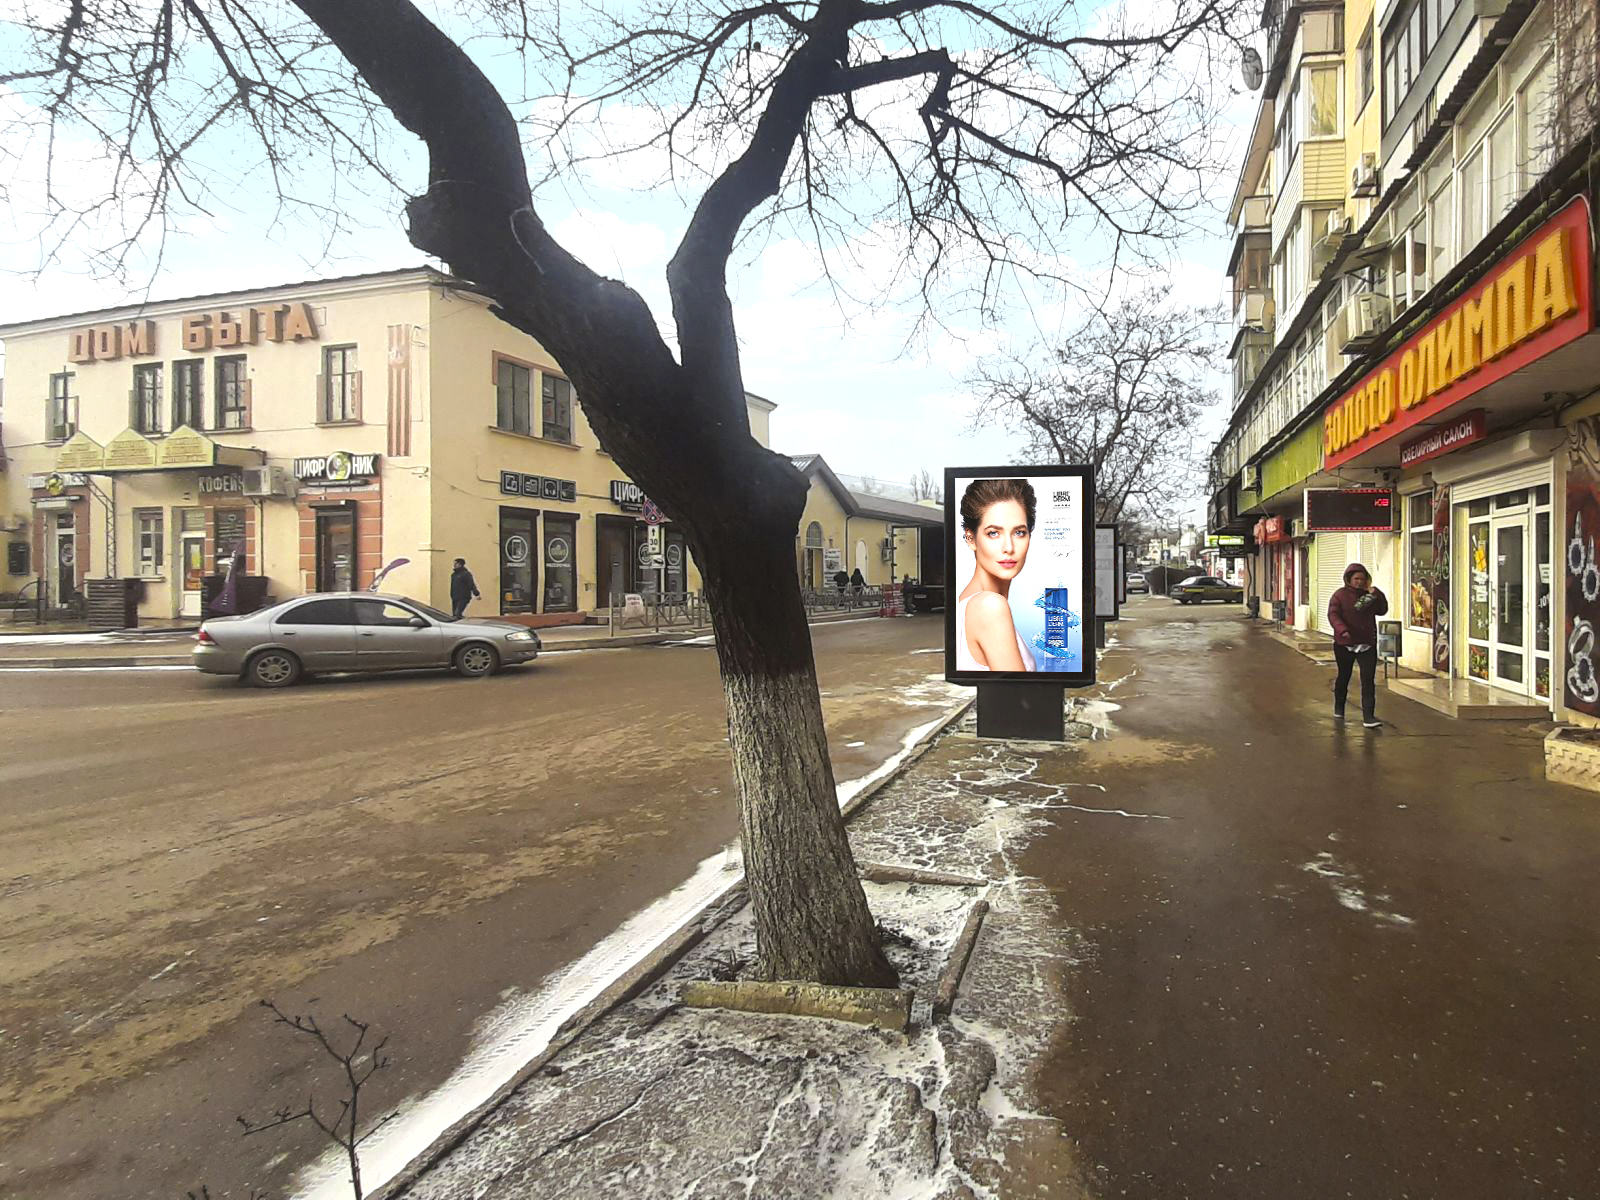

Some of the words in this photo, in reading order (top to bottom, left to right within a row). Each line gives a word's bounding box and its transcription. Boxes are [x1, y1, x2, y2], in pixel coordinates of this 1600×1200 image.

[68, 319, 156, 364] ДОМ
[182, 302, 319, 350] БЫТА
[1325, 368, 1396, 457] ЗОЛОТО
[1399, 227, 1578, 411] ОЛИМПА
[1401, 432, 1442, 464] ЮВЕЛИРНЫЙ
[1443, 420, 1473, 446] САЛОН
[649, 538, 659, 546] 30
